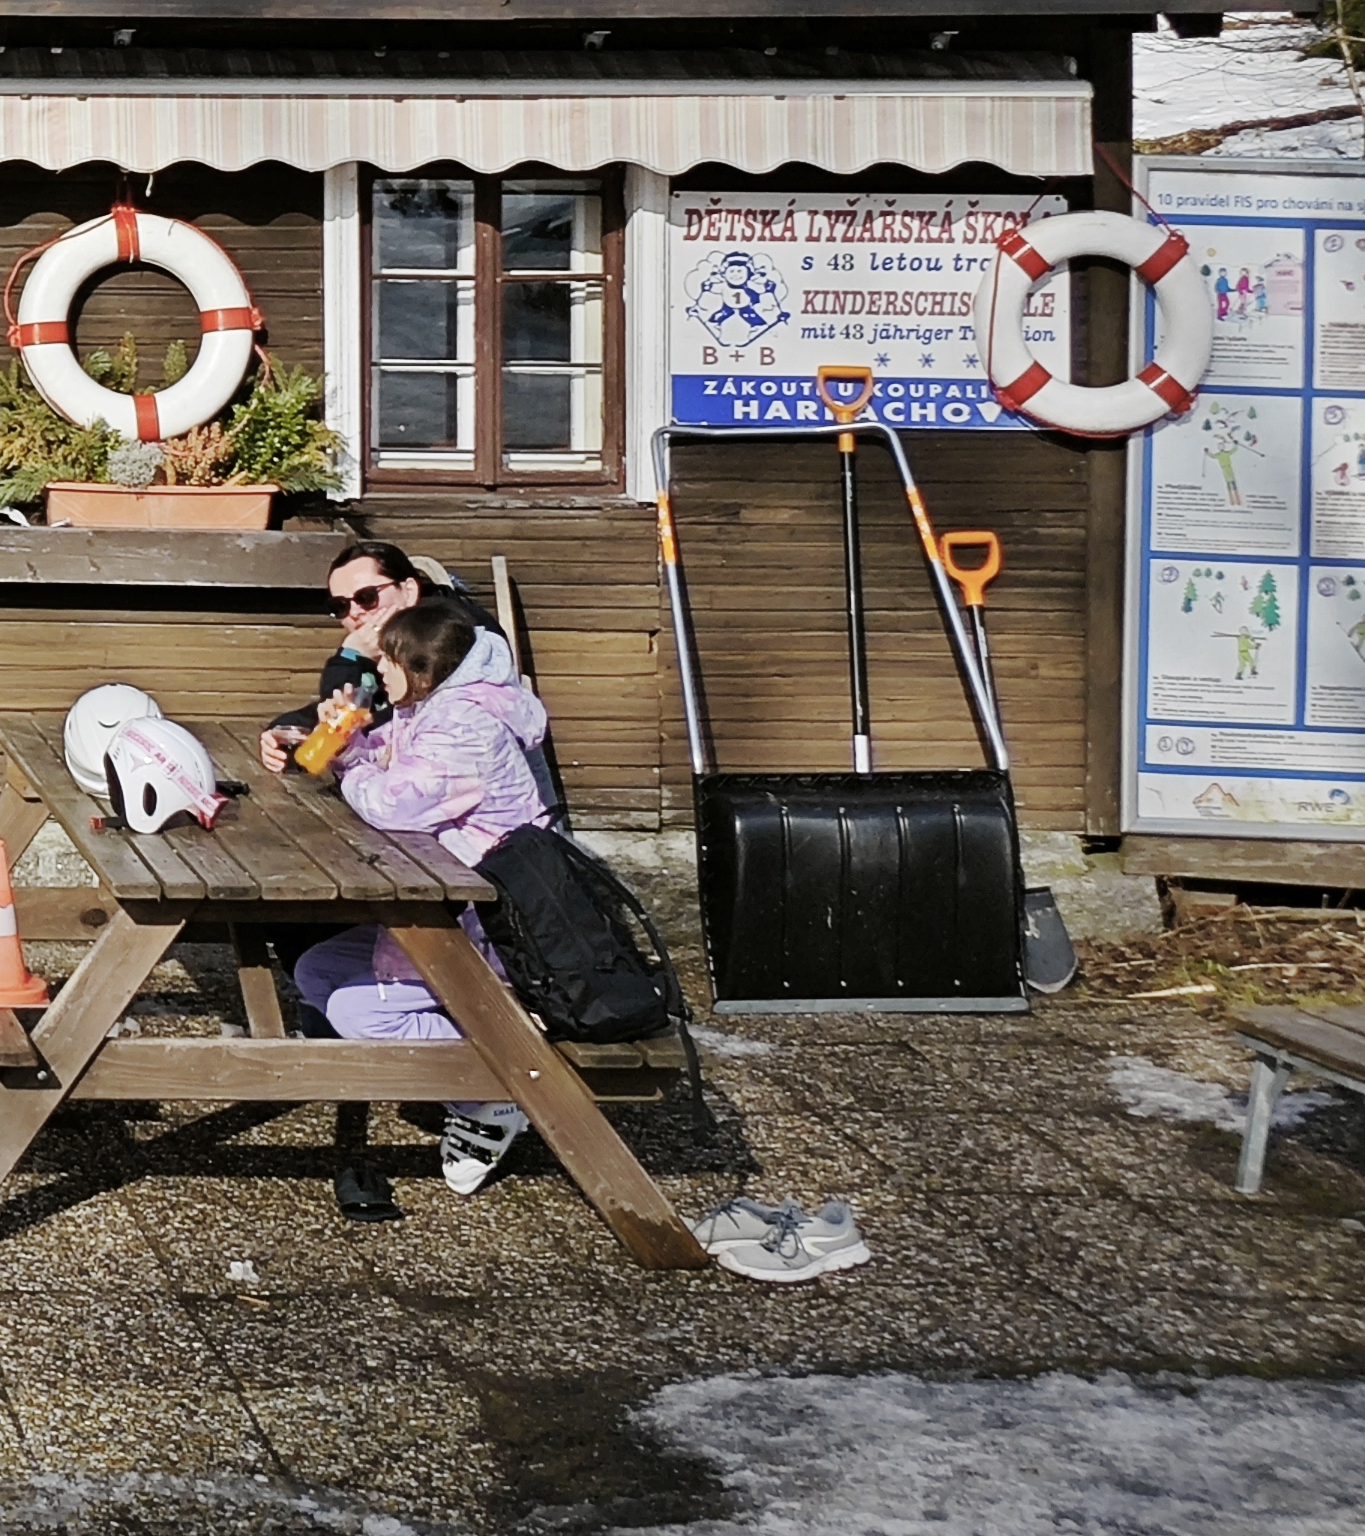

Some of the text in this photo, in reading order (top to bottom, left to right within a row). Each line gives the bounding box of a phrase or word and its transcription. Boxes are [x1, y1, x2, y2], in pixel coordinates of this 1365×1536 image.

[1158, 194, 1172, 205] 10
[1176, 194, 1230, 208] pravidel
[1234, 195, 1252, 208] FIS
[1256, 198, 1279, 211] pro
[1282, 196, 1333, 211] chování
[1337, 201, 1352, 211] na
[683, 197, 797, 241] DĚTSKÁ
[805, 197, 955, 243] LYŽAŘSKÁ
[801, 255, 814, 271] s
[826, 253, 855, 271] 43
[870, 252, 943, 272] letou
[732, 292, 741, 304] 1
[801, 290, 1056, 317] KINDERSCHISLE
[801, 323, 836, 339] mit
[839, 323, 864, 339] 43
[868, 324, 954, 344] jähriger
[702, 346, 718, 365] B
[760, 346, 776, 365] B
[703, 378, 820, 396] ZÁKOUT
[838, 382, 854, 396] U
